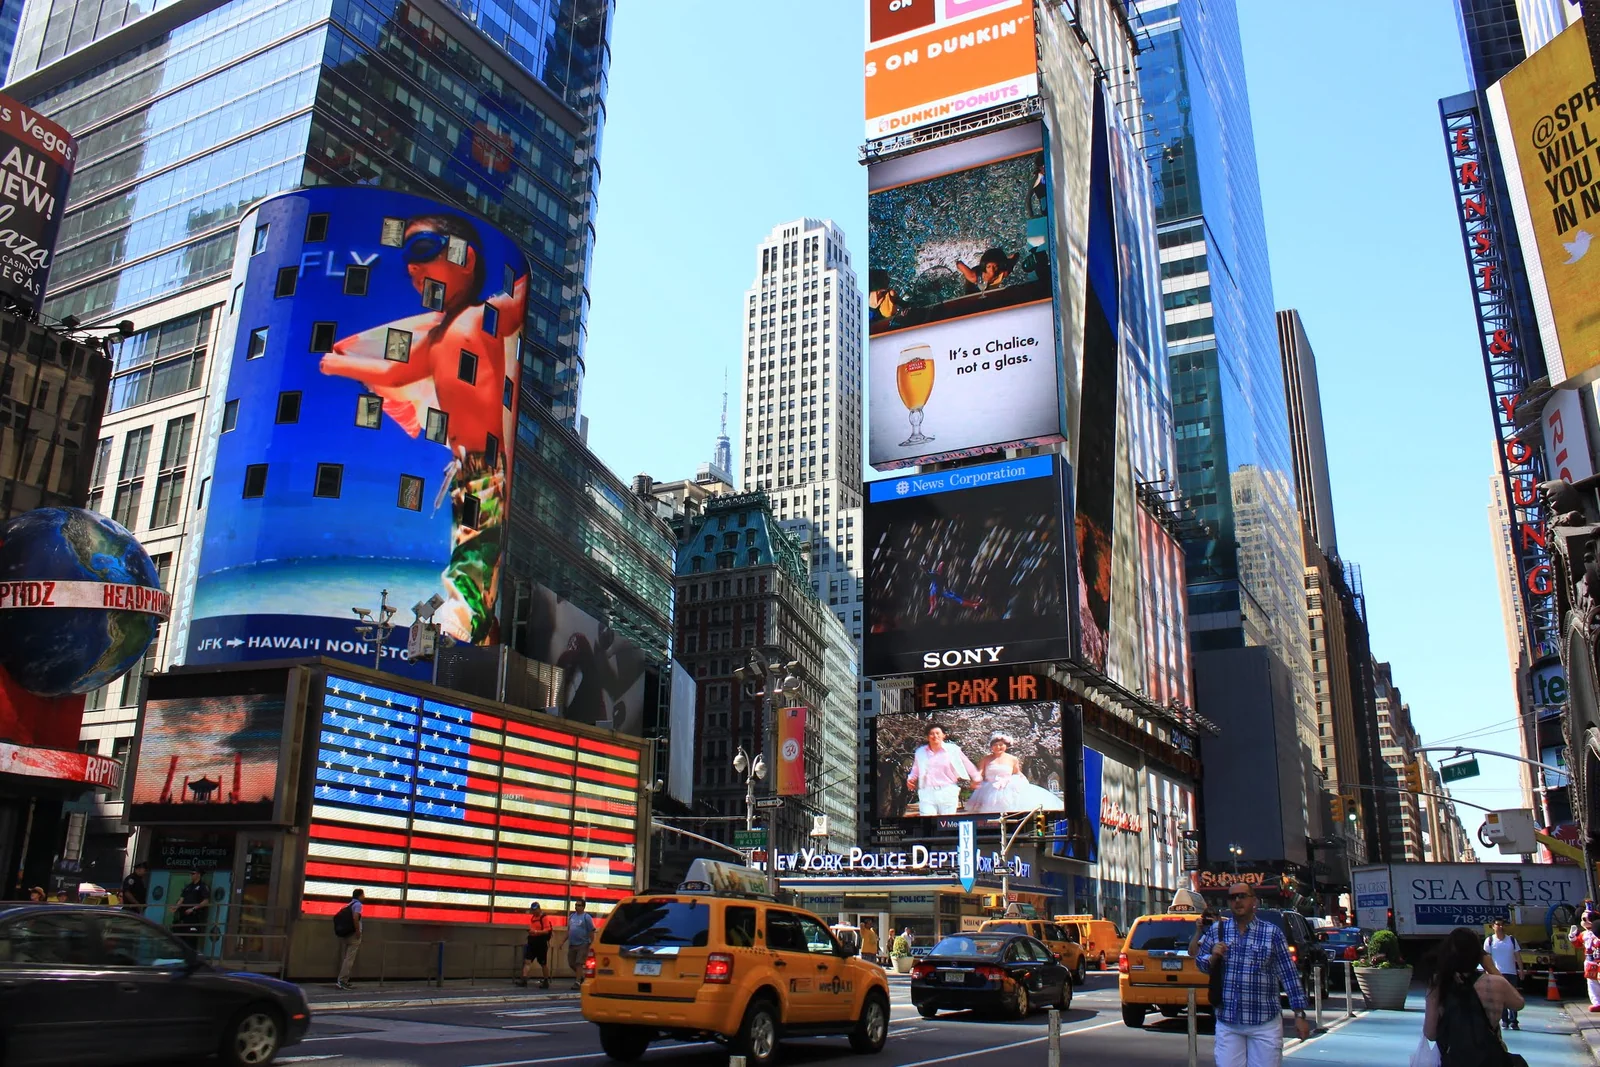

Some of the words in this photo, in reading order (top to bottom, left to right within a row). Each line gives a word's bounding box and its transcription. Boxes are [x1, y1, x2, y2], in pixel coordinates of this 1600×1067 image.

[885, 49, 919, 71] ON
[927, 17, 1024, 59] DUNKIN'
[0, 105, 12, 122] s
[20, 110, 72, 160] Vegas
[1538, 122, 1597, 174] WILL
[1, 146, 48, 188] ALL
[1544, 154, 1592, 205] YOU
[1456, 128, 1496, 291] ERNST
[1552, 198, 1579, 236] IN
[2, 255, 33, 275] CASINO
[299, 250, 379, 277] FLY
[0, 263, 40, 295] EGAS
[949, 347, 968, 360] It's
[972, 347, 980, 356] a
[985, 336, 1039, 353] Chalice,
[1490, 329, 1512, 354] &
[957, 362, 977, 375] not
[981, 361, 990, 370] a
[995, 354, 1032, 371] glass.
[912, 478, 945, 492] News
[950, 466, 1026, 487] Corporation
[1500, 394, 1553, 594] YOUNG
[174, 532, 202, 667] MARKET
[198, 637, 222, 651] JFK
[326, 639, 410, 661] NON-STO
[923, 646, 1004, 669] SONY
[877, 680, 912, 689] SHERWOOD
[1008, 674, 1037, 701] HR
[166, 857, 191, 866] CAREER
[801, 847, 844, 871] YORK
[850, 846, 907, 870] POLICE
[912, 844, 958, 870] DEPT
[963, 823, 971, 877] NYPD
[1201, 871, 1265, 886] Subway
[1412, 879, 1470, 900] SEA
[1476, 880, 1572, 901] CREST
[898, 895, 926, 903] POLICE
[1418, 906, 1462, 914] LINEN
[1467, 906, 1508, 915] SUPPL
